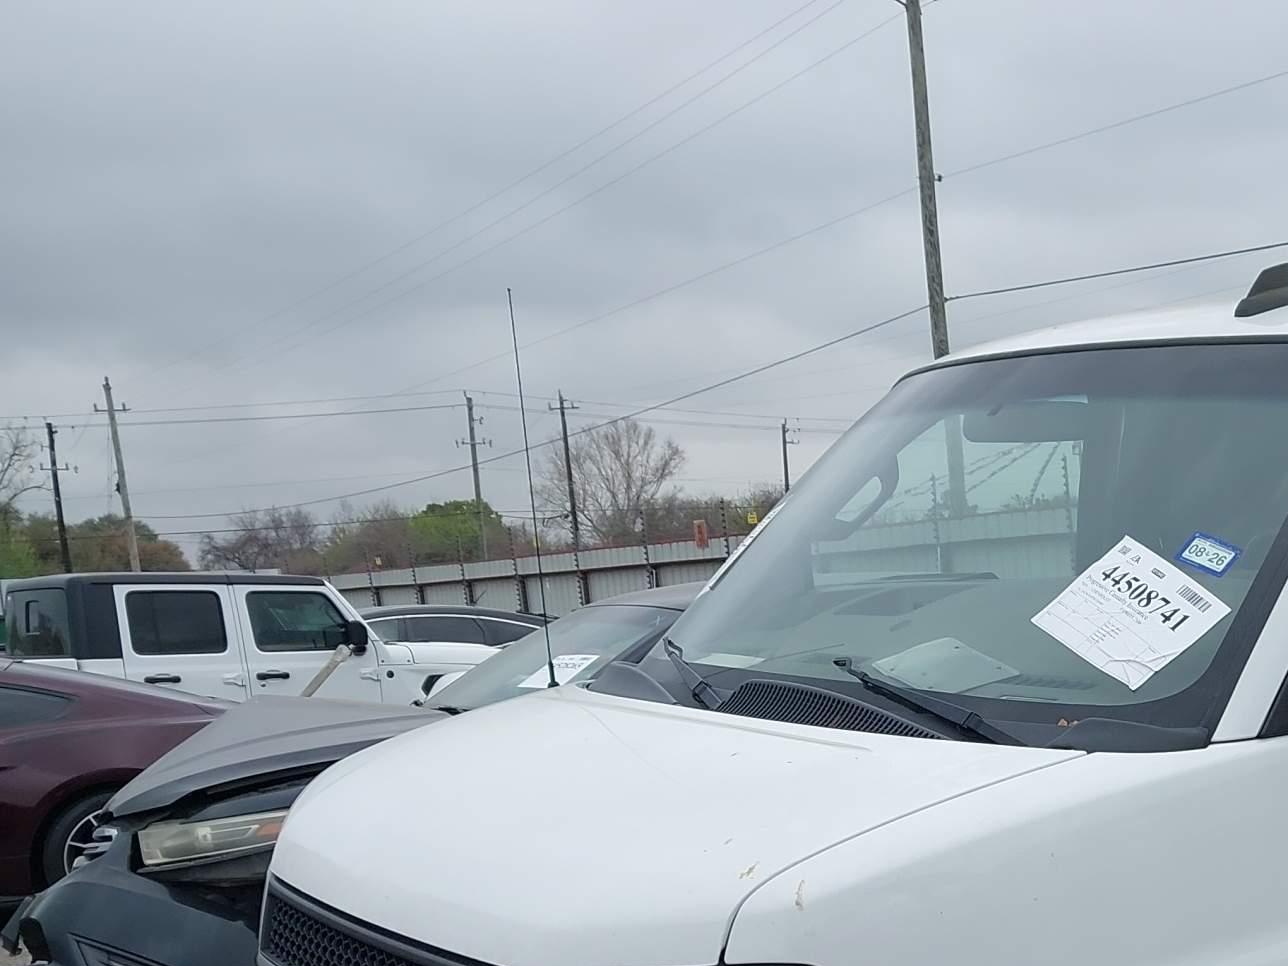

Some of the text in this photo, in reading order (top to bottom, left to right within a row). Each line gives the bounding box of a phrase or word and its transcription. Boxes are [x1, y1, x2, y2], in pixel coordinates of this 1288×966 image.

[1188, 543, 1206, 558] 08
[1207, 552, 1228, 567] 26
[1101, 565, 1191, 632] 44508741
